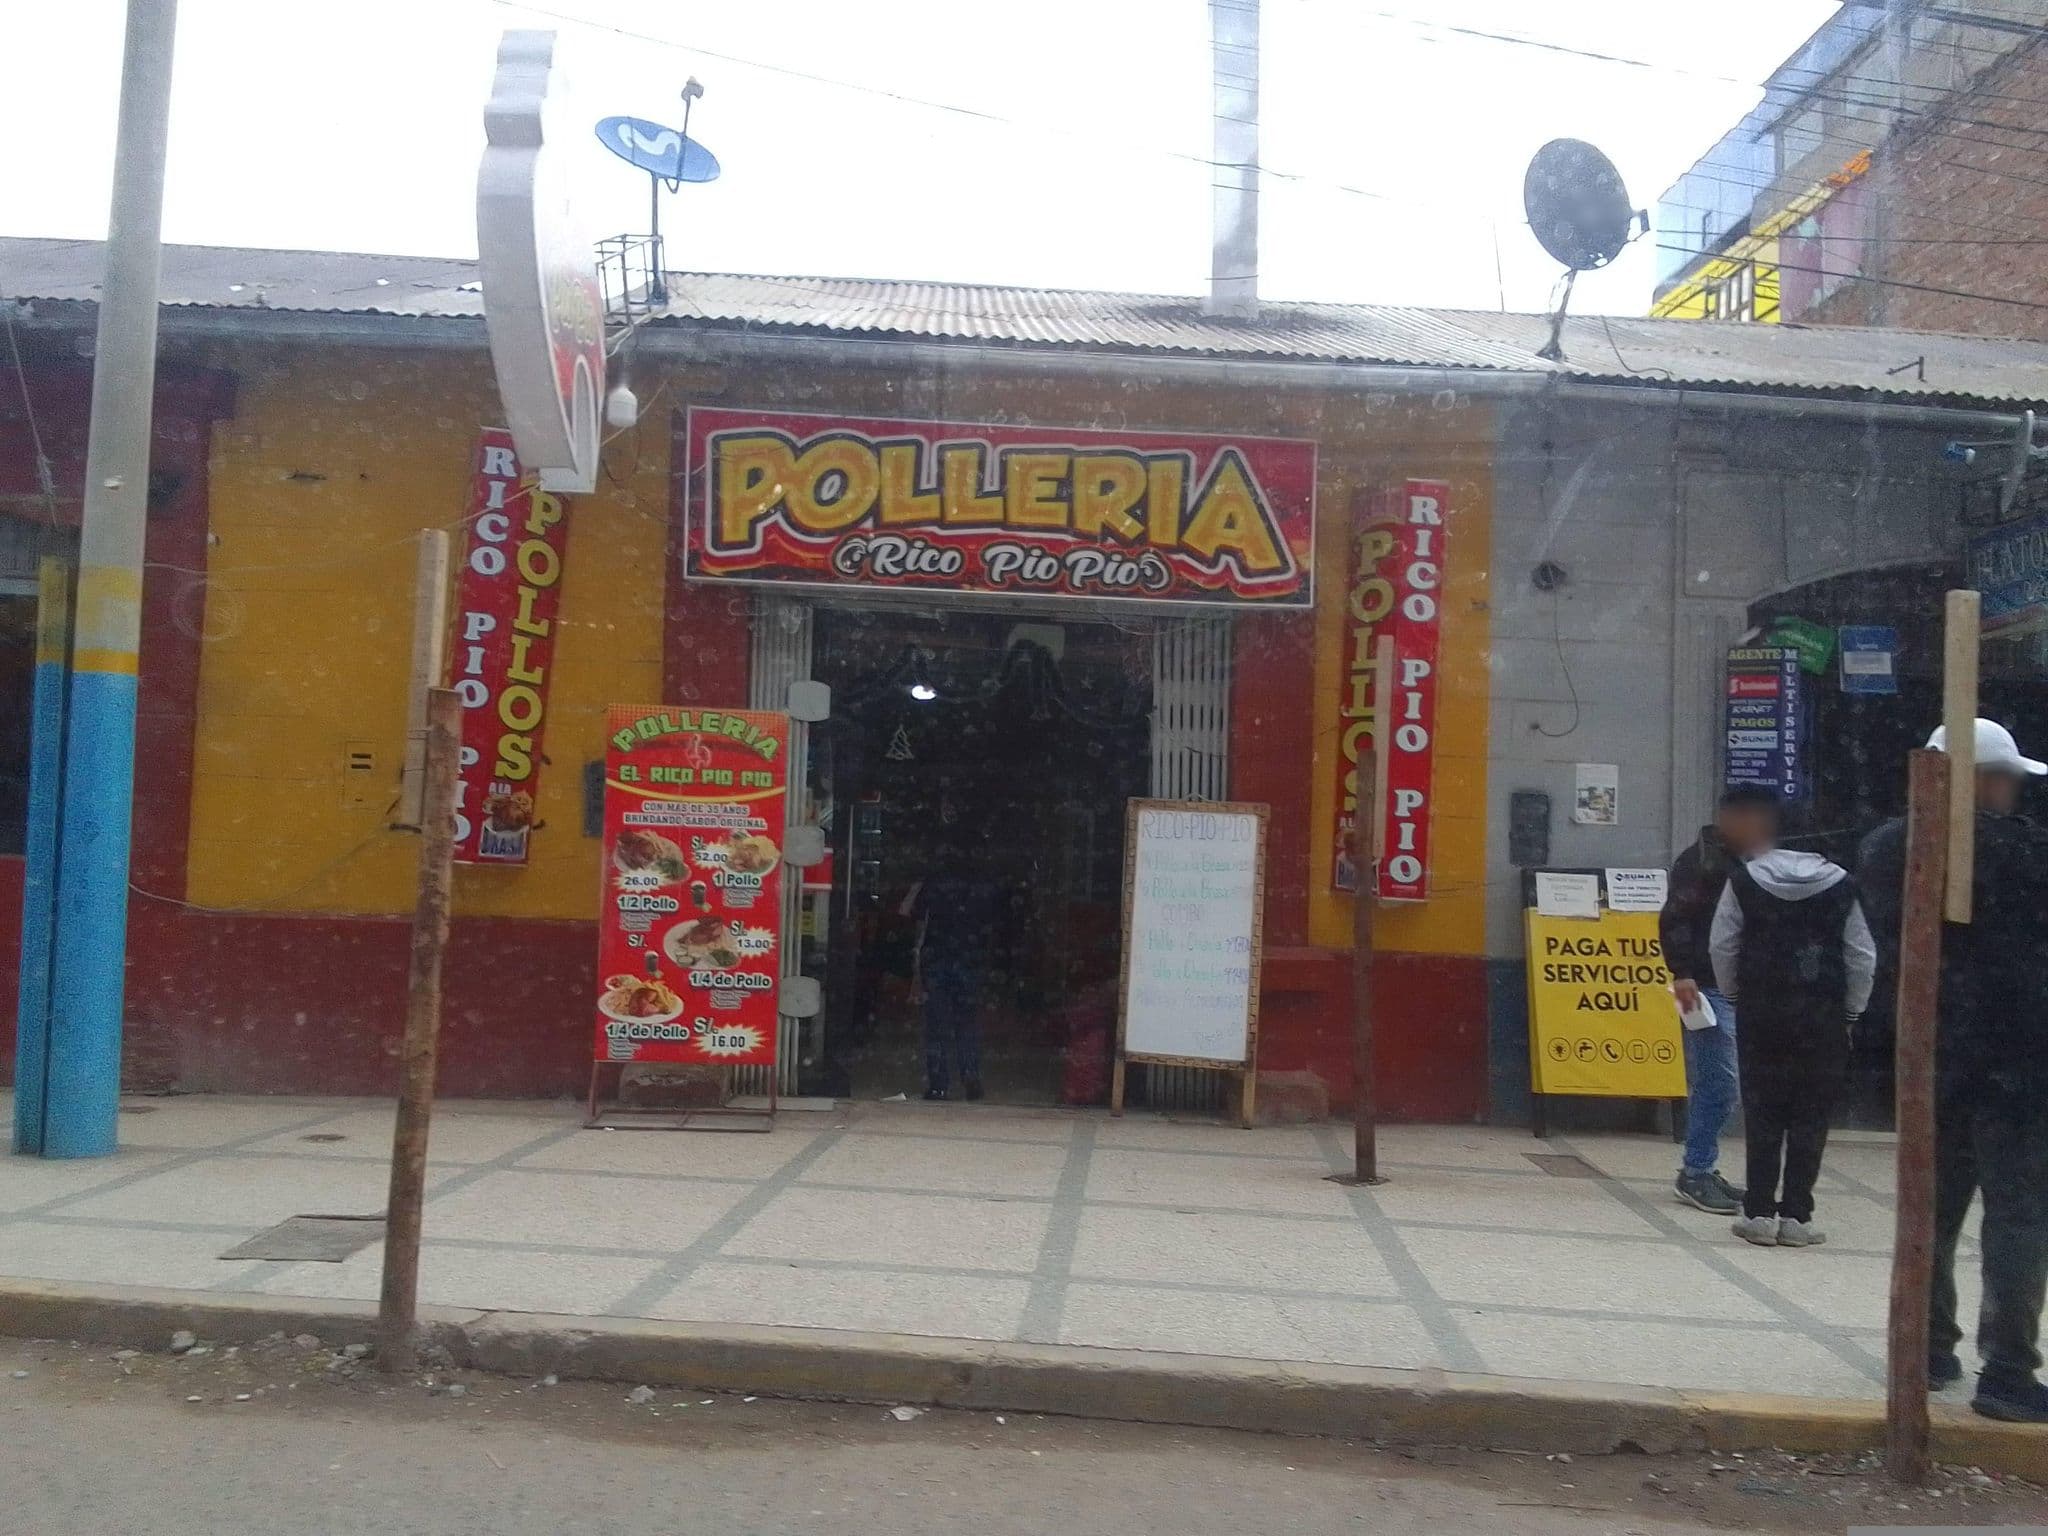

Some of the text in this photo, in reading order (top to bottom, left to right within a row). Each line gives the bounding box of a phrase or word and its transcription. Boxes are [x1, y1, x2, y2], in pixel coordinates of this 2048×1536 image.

[470, 446, 518, 575] RICO
[714, 433, 1285, 572] POLLERIA
[867, 534, 1139, 591] Rico Pio Pio
[1402, 496, 1442, 622] RICO
[495, 489, 563, 781] POLLOS
[453, 612, 496, 708] PIO
[1728, 649, 1781, 660] AGENTE
[1395, 659, 1431, 752] PIO
[1731, 717, 1776, 728] PAGOS
[1784, 649, 1798, 799] MULTISERVIC
[612, 711, 780, 762] POLLERIA
[1741, 735, 1777, 743] SUNAT
[619, 764, 773, 787] EL RICO PIO PIO
[643, 802, 663, 813] CON
[666, 803, 687, 814] MAS
[691, 804, 704, 814] DE
[624, 814, 766, 829] BRINDANDO SABOR ORIGINAL
[1388, 789, 1424, 884] PIO
[623, 876, 659, 887] 26.00
[713, 873, 760, 887] 1 Pollo
[618, 896, 677, 910] 1/2 Pollo
[737, 937, 770, 949] 13.00
[1546, 936, 1661, 958] PAGA TUS
[690, 972, 770, 988] 1/4 de Pollo
[1543, 963, 1668, 985] SERVICIOS
[1576, 987, 1640, 1012] AQUÍ
[607, 1024, 688, 1038] 1/4 de Pollo
[711, 1035, 746, 1048] 16.00
